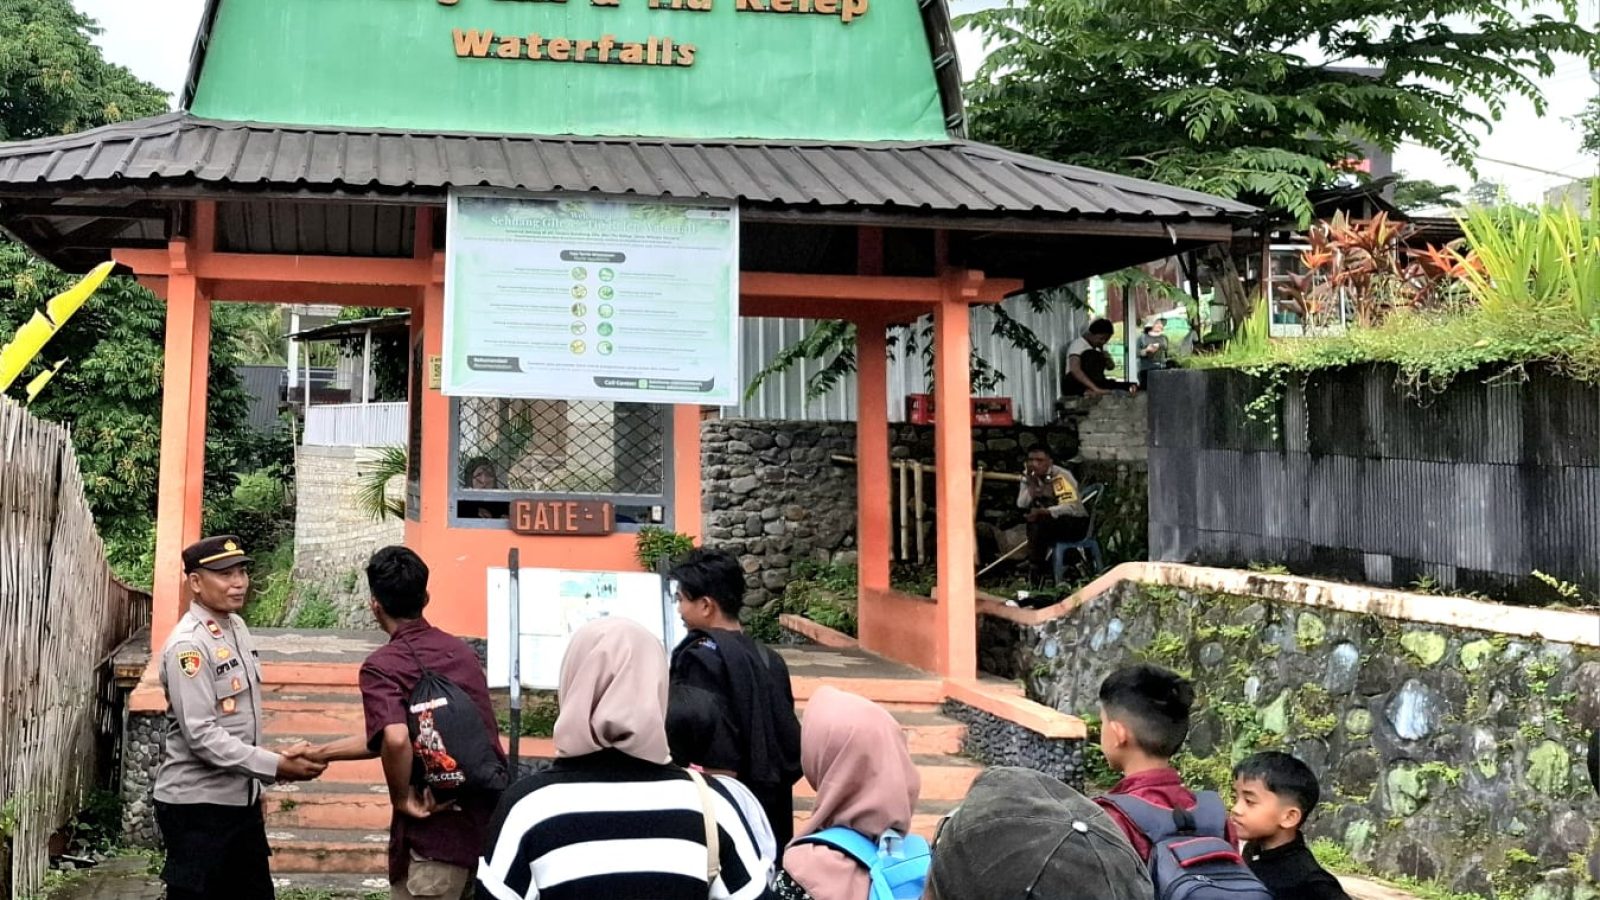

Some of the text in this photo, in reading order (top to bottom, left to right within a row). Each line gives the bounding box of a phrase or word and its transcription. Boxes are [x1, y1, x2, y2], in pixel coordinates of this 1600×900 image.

[452, 27, 696, 66] Waterfalls
[516, 501, 579, 531] GATE
[602, 502, 611, 532] 1
